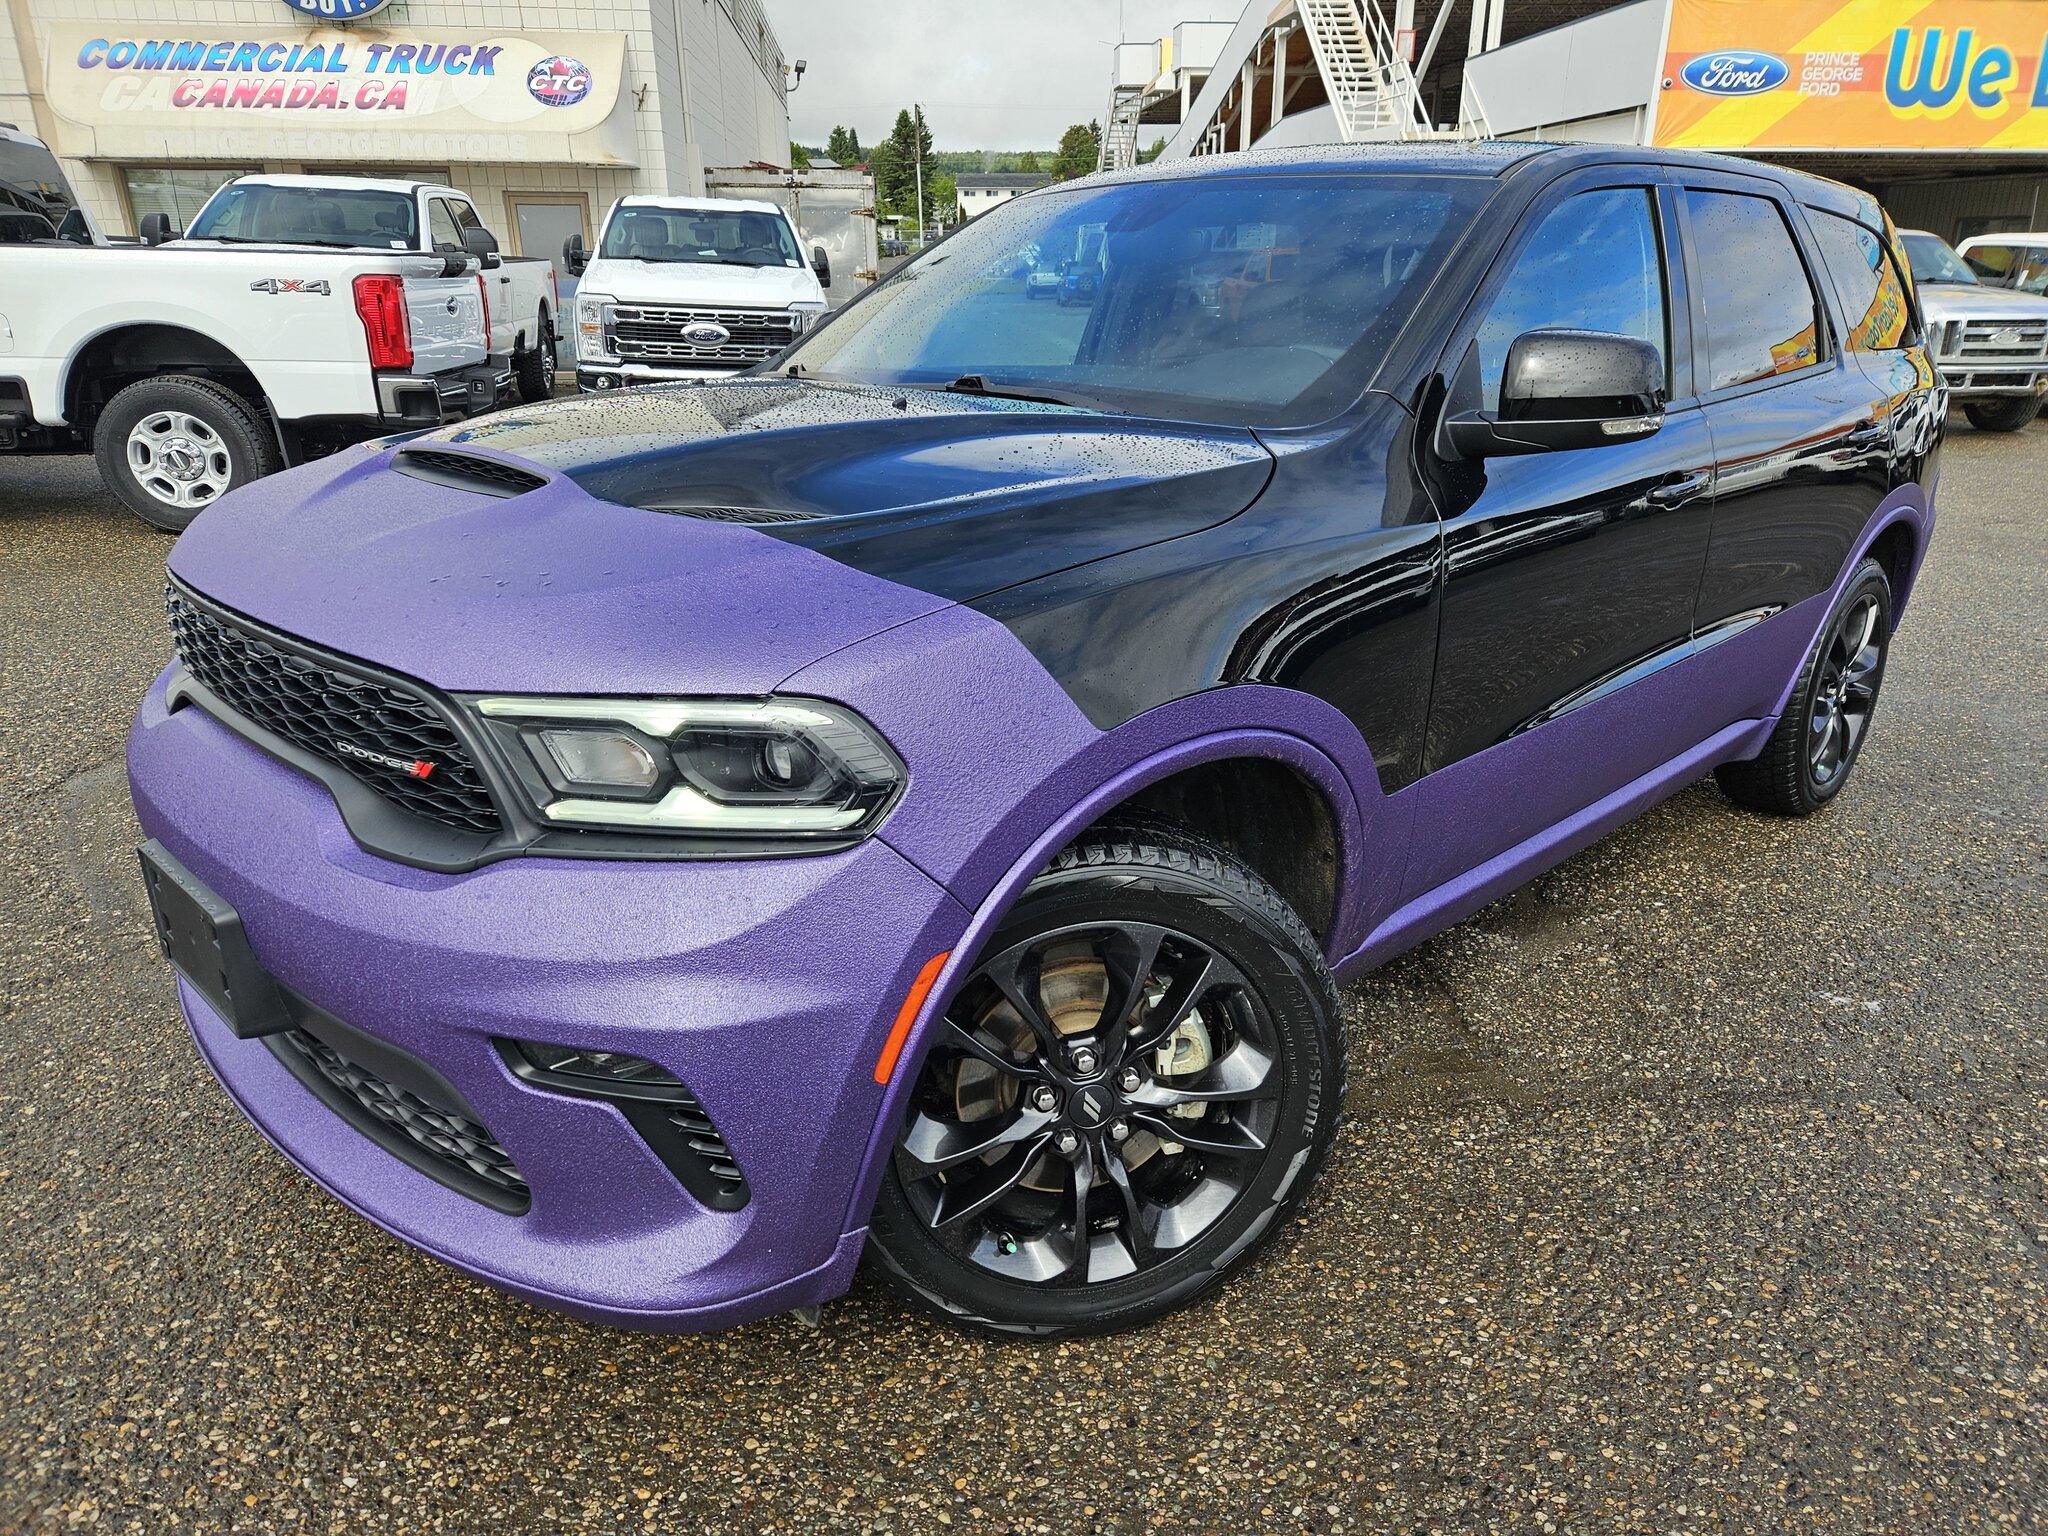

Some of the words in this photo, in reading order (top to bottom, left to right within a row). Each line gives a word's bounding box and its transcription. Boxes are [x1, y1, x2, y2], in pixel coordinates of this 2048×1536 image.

[77, 38, 348, 73] COMMERCIAL
[365, 43, 504, 76] TRUCK
[1701, 56, 1769, 88] Ford
[1804, 52, 1861, 67] PRINCE
[1884, 27, 2013, 109] We
[530, 75, 588, 91] CTC
[1798, 81, 1841, 97] FORD
[1801, 66, 1864, 82] GEORGE
[172, 78, 409, 110] CANADA.CA
[336, 740, 420, 775] DODGE
